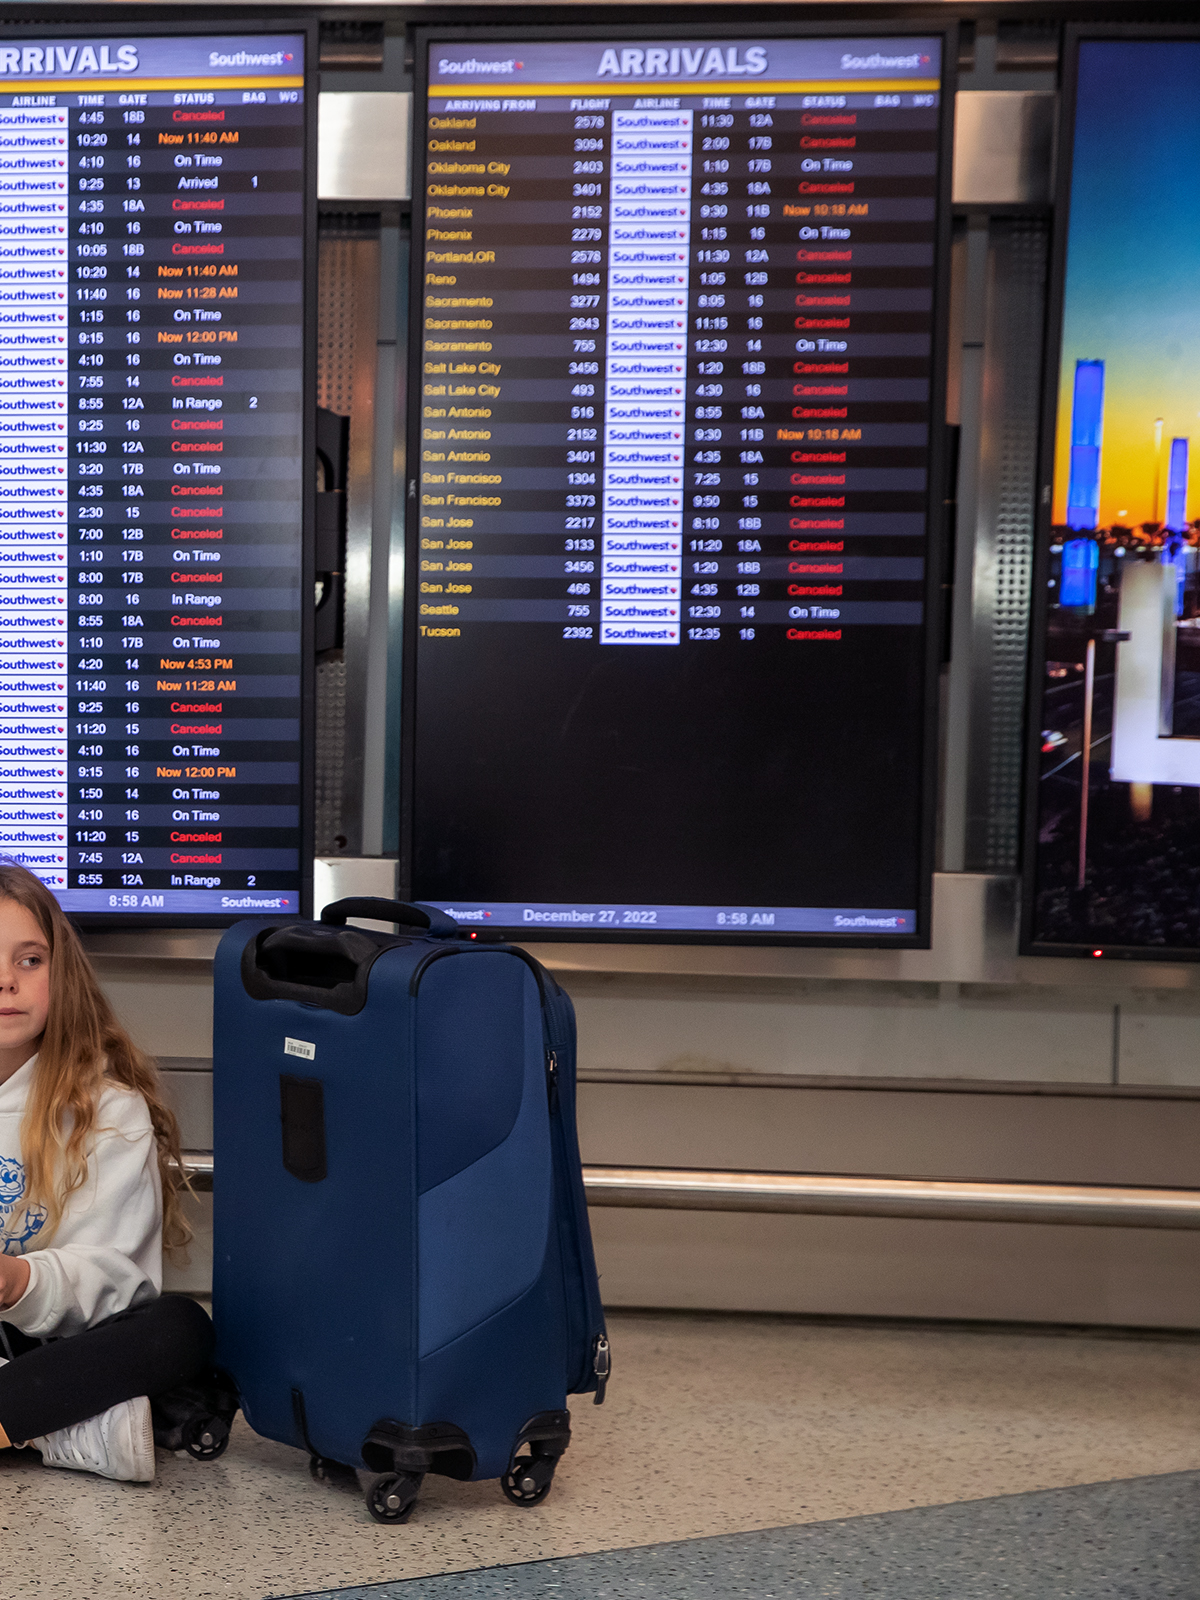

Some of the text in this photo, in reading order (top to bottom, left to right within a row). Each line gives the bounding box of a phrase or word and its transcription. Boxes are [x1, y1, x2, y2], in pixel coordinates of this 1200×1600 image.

[209, 51, 284, 66] Southwest
[439, 48, 920, 76] Southwest ARRIVALS Southwest
[12, 95, 56, 107] AIRLINE
[78, 95, 104, 106] TIME
[119, 94, 147, 105] GATE
[173, 93, 214, 104] STATUS
[243, 92, 266, 103] BAG
[446, 96, 846, 111] ARRIVING FROM FLIGHT AIRLINE TIME GATE STATUS
[79, 111, 104, 124] 4:45
[123, 111, 144, 124] 18B
[173, 110, 225, 122] Canceled
[79, 178, 104, 190] 9:25
[127, 177, 141, 190] 13
[178, 176, 218, 189] Arrived
[251, 176, 258, 188] 1
[78, 398, 104, 410] 8:55
[122, 397, 144, 409] 12A
[172, 397, 181, 409] In
[185, 397, 222, 411] Range
[249, 397, 258, 409] 2
[78, 506, 103, 518] 2:30
[126, 506, 140, 518] 15
[171, 506, 223, 518] Canceled
[421, 538, 443, 550] San
[446, 538, 473, 550] Jose
[565, 538, 595, 551] 3133
[606, 539, 670, 551] Southwest
[789, 540, 843, 552] Canceled
[78, 594, 103, 605] 8:00
[126, 594, 140, 605] 16
[172, 593, 181, 605] In
[184, 593, 222, 607] Range
[420, 604, 459, 616] Seattle
[567, 605, 589, 617] 755
[605, 605, 669, 618] Southwest
[740, 606, 755, 619] 14
[789, 606, 807, 618] On
[811, 606, 840, 618] Time
[421, 626, 842, 640] Tucson 2392 Southwest 12:35 16 Canceled
[76, 680, 106, 692] 11:40
[125, 680, 139, 692] 16
[157, 680, 182, 692] Now
[185, 680, 214, 692] 11:28
[217, 680, 236, 692] AM
[79, 788, 103, 800] 1:50
[125, 788, 139, 800] 14
[173, 789, 189, 800] On
[193, 789, 220, 800] Time
[76, 831, 106, 843] 11:20
[125, 831, 139, 843] 15
[171, 831, 222, 843] Canceled
[78, 874, 103, 885] 8:55
[121, 874, 143, 886] 12A
[171, 874, 180, 886] In
[184, 874, 221, 888] Range
[247, 875, 255, 886] 2
[109, 895, 140, 908] 8:58
[143, 895, 164, 908] AM
[221, 896, 281, 909] Southwest
[523, 909, 595, 923] December
[599, 910, 620, 924] 27,
[623, 910, 657, 923] 2022
[717, 912, 748, 925] 8:58
[751, 912, 775, 925] AM
[834, 915, 897, 927] Southwest
